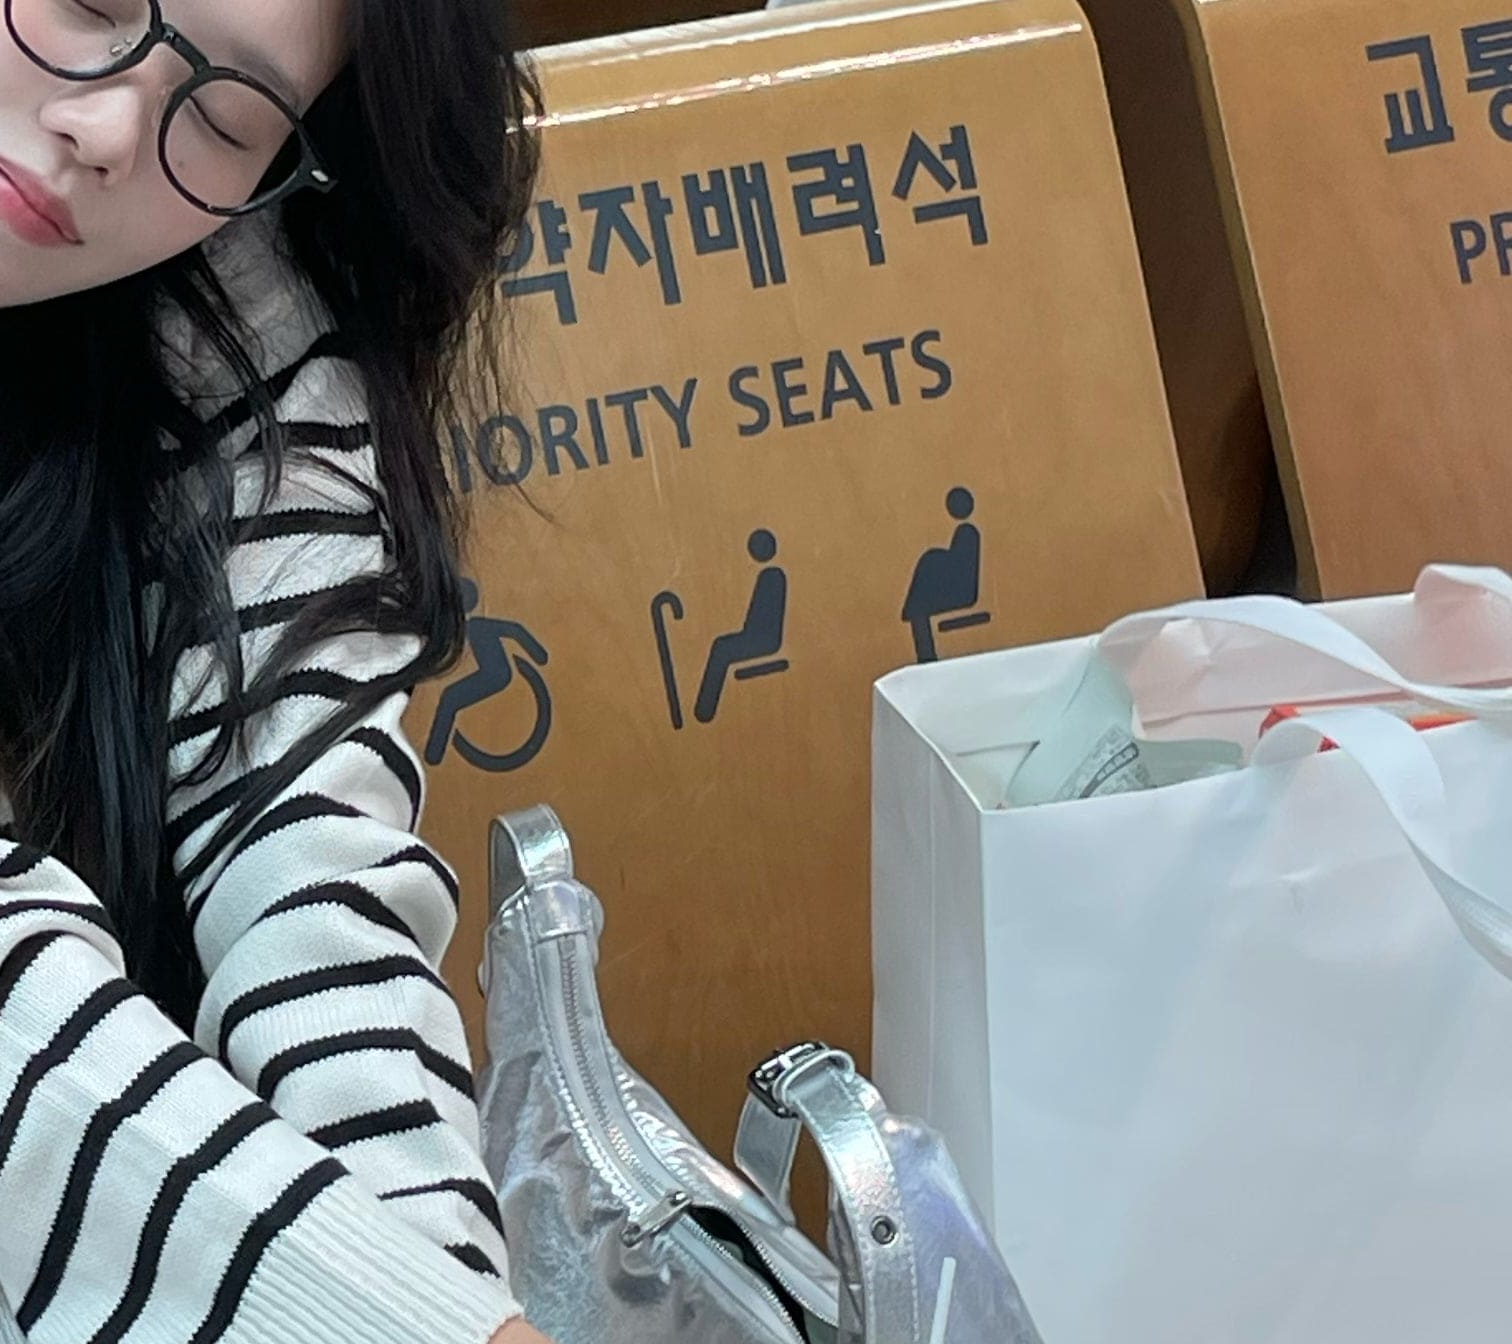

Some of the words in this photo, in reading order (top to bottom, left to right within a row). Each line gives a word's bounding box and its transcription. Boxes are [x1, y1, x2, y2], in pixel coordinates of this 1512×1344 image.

[493, 124, 988, 325] 약자배려석
[449, 378, 698, 494] IORITY
[729, 330, 952, 437] SEATS
